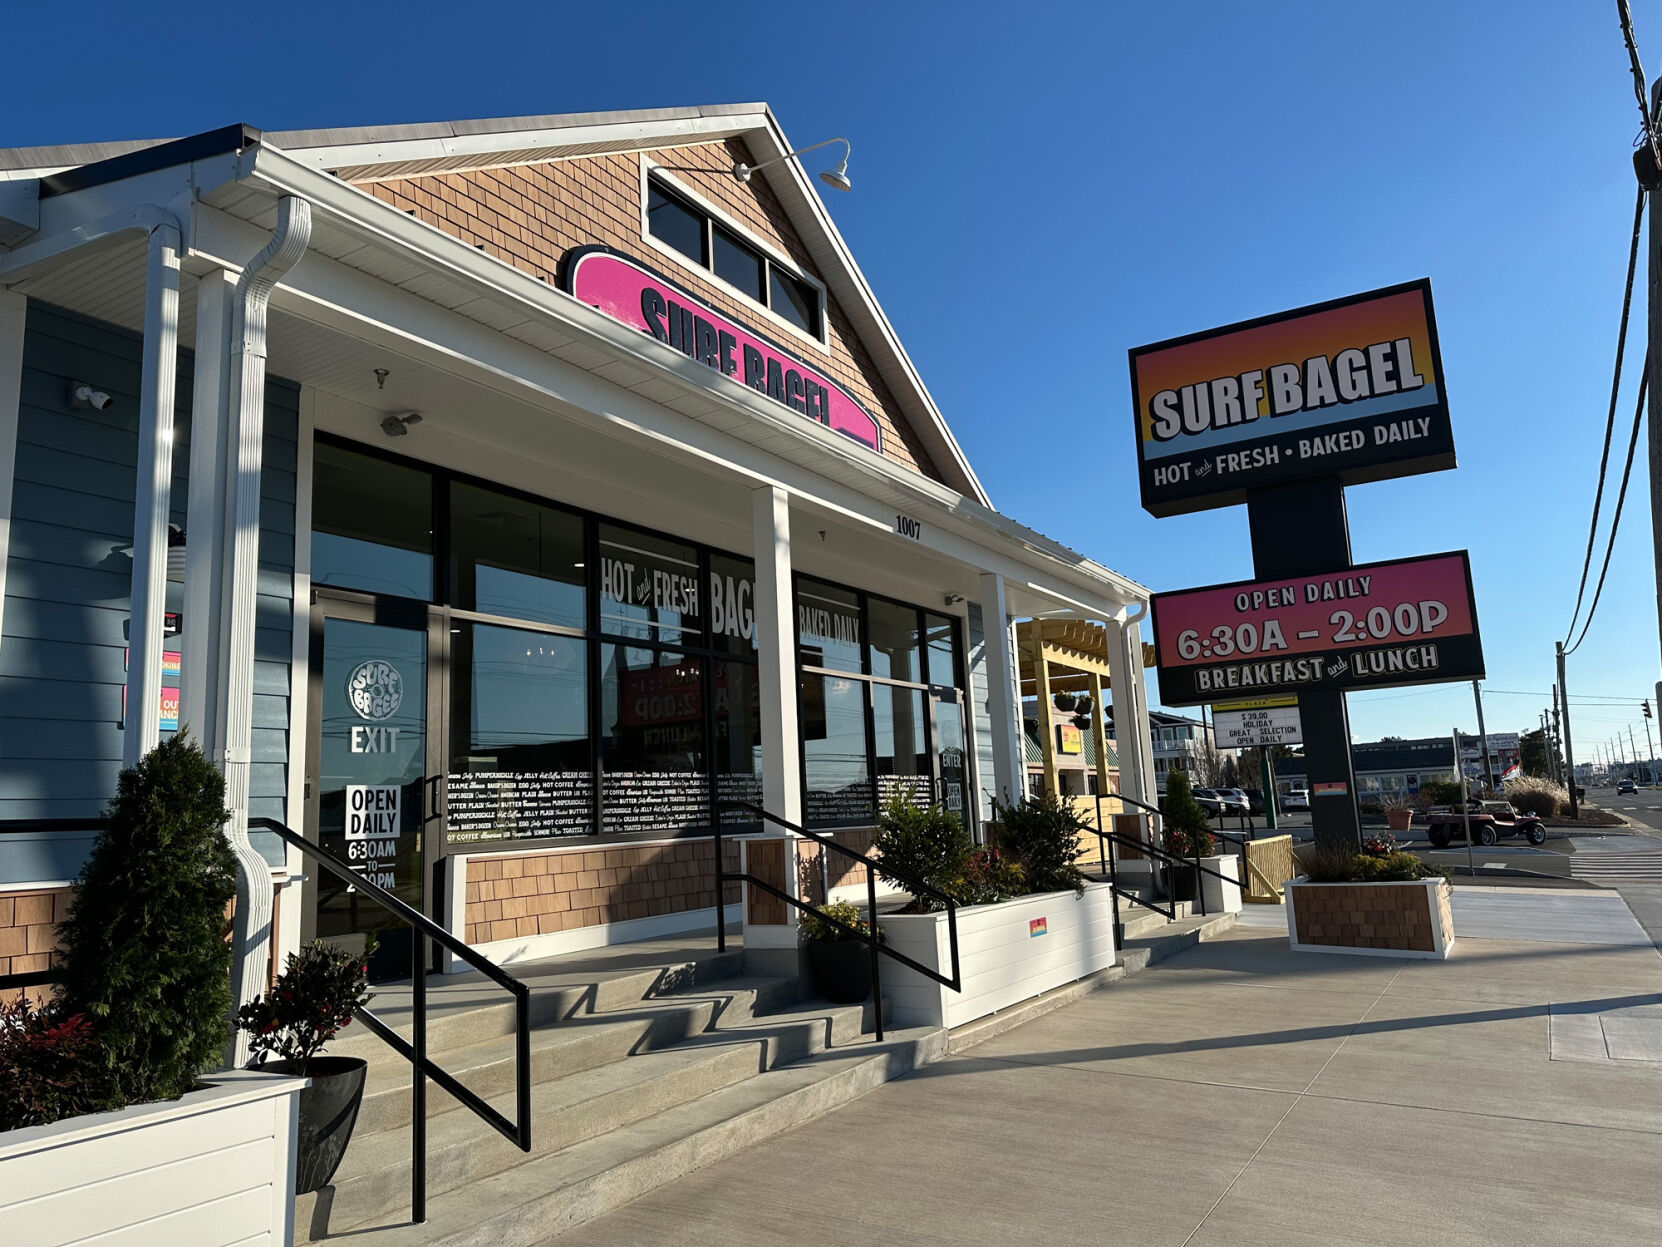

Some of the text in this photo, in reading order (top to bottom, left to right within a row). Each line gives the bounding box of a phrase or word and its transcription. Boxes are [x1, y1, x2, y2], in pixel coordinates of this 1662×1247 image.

[641, 287, 737, 377] SURF
[1150, 338, 1424, 441] SURF BAGEL
[1154, 417, 1431, 487] HOT and FRESH BAKED DAILY
[896, 515, 920, 540] 1007
[601, 557, 699, 617] HOT and FRESH
[1235, 576, 1372, 612] OPEN DAILY
[799, 605, 860, 646] BAKED DAILY
[1177, 619, 1288, 660] 6:30A
[1329, 600, 1449, 644] 2:00P
[353, 663, 398, 693] SURF
[1198, 645, 1438, 691] BREAKFAST and LUNCH
[354, 689, 399, 717] BAGEL
[1229, 726, 1297, 738] GREAT SELECTION
[1243, 720, 1273, 729] HOLIDAY
[351, 726, 400, 753] EXIT
[1261, 735, 1282, 744] DAILY
[943, 754, 961, 768] ENTER
[352, 789, 396, 811] OPEN
[351, 812, 396, 834] DAILY
[348, 840, 396, 860] 6:30AM
[367, 860, 378, 872] TO
